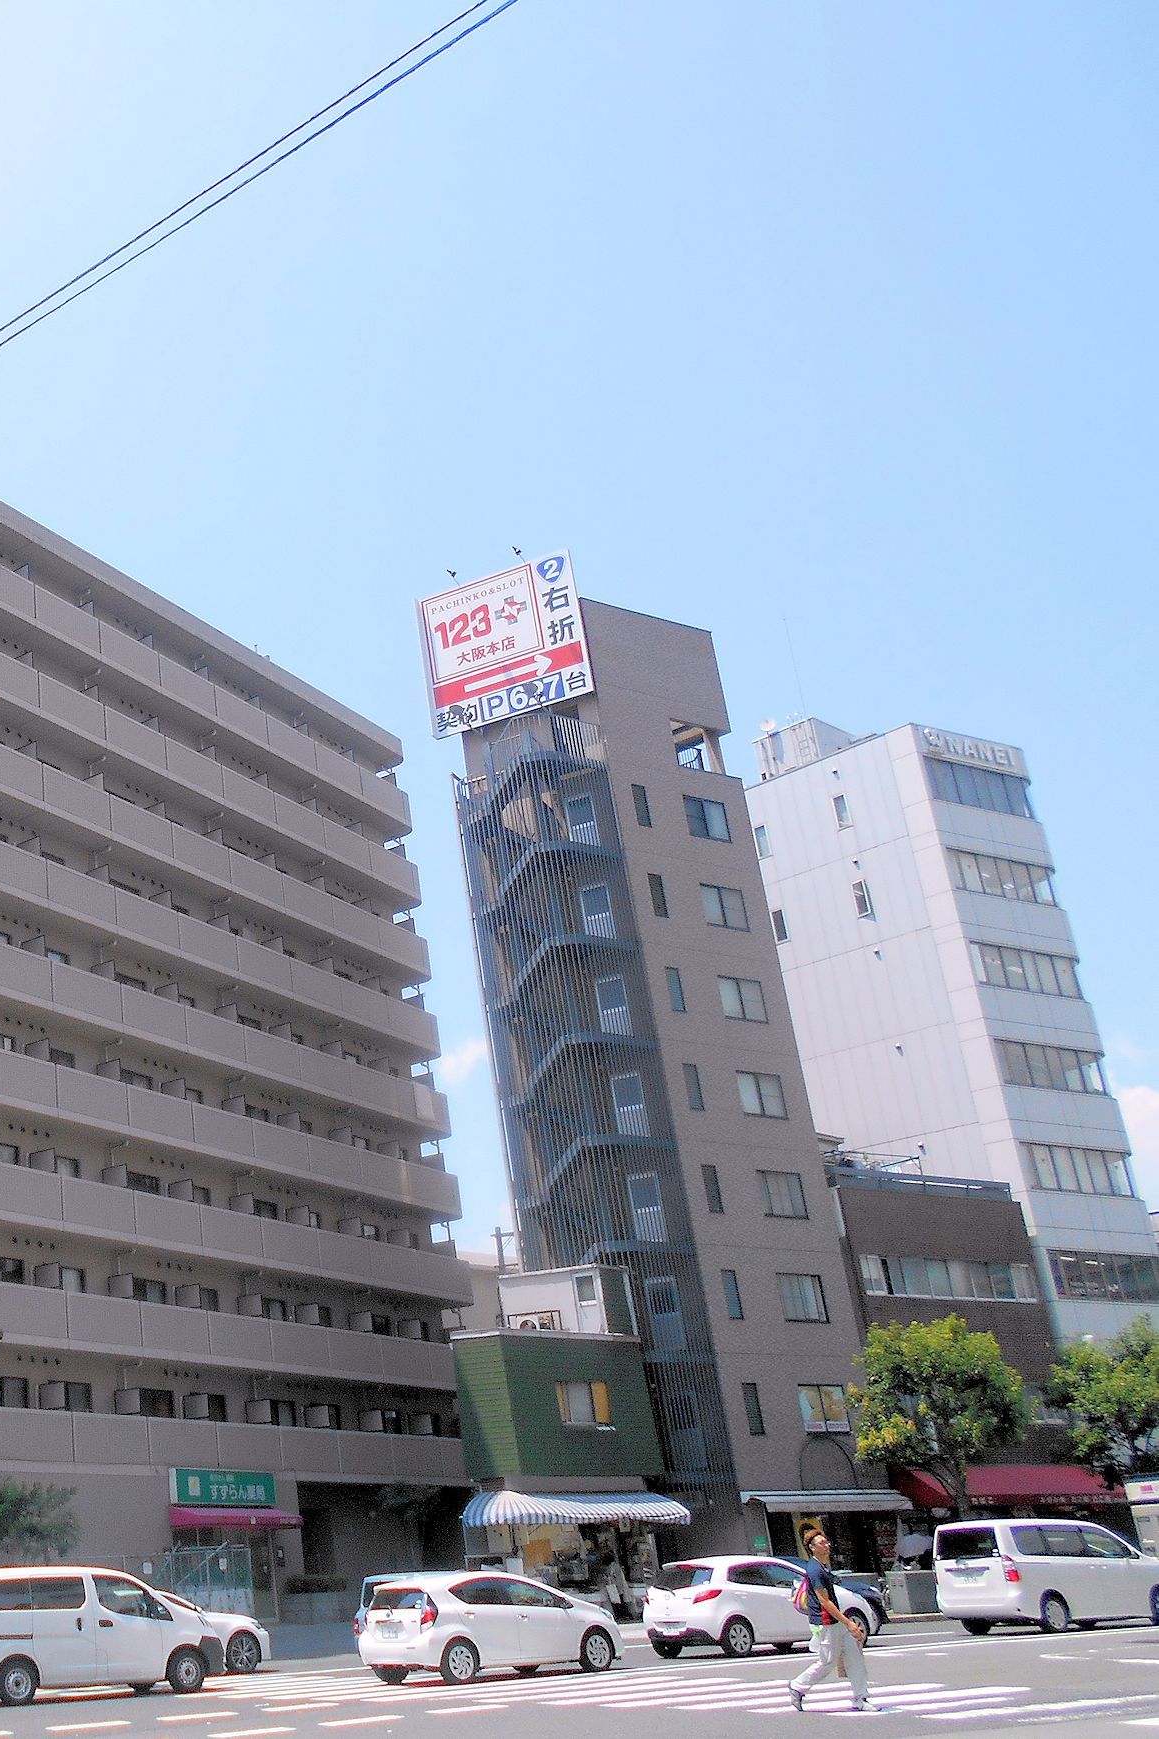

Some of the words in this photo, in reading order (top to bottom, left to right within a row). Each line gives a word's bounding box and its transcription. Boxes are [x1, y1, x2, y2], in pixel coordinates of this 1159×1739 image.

[434, 603, 493, 650] 123
[541, 585, 575, 646] 右折
[457, 635, 516, 667] 大阪本店
[209, 1483, 266, 1502] すずらん薬局
